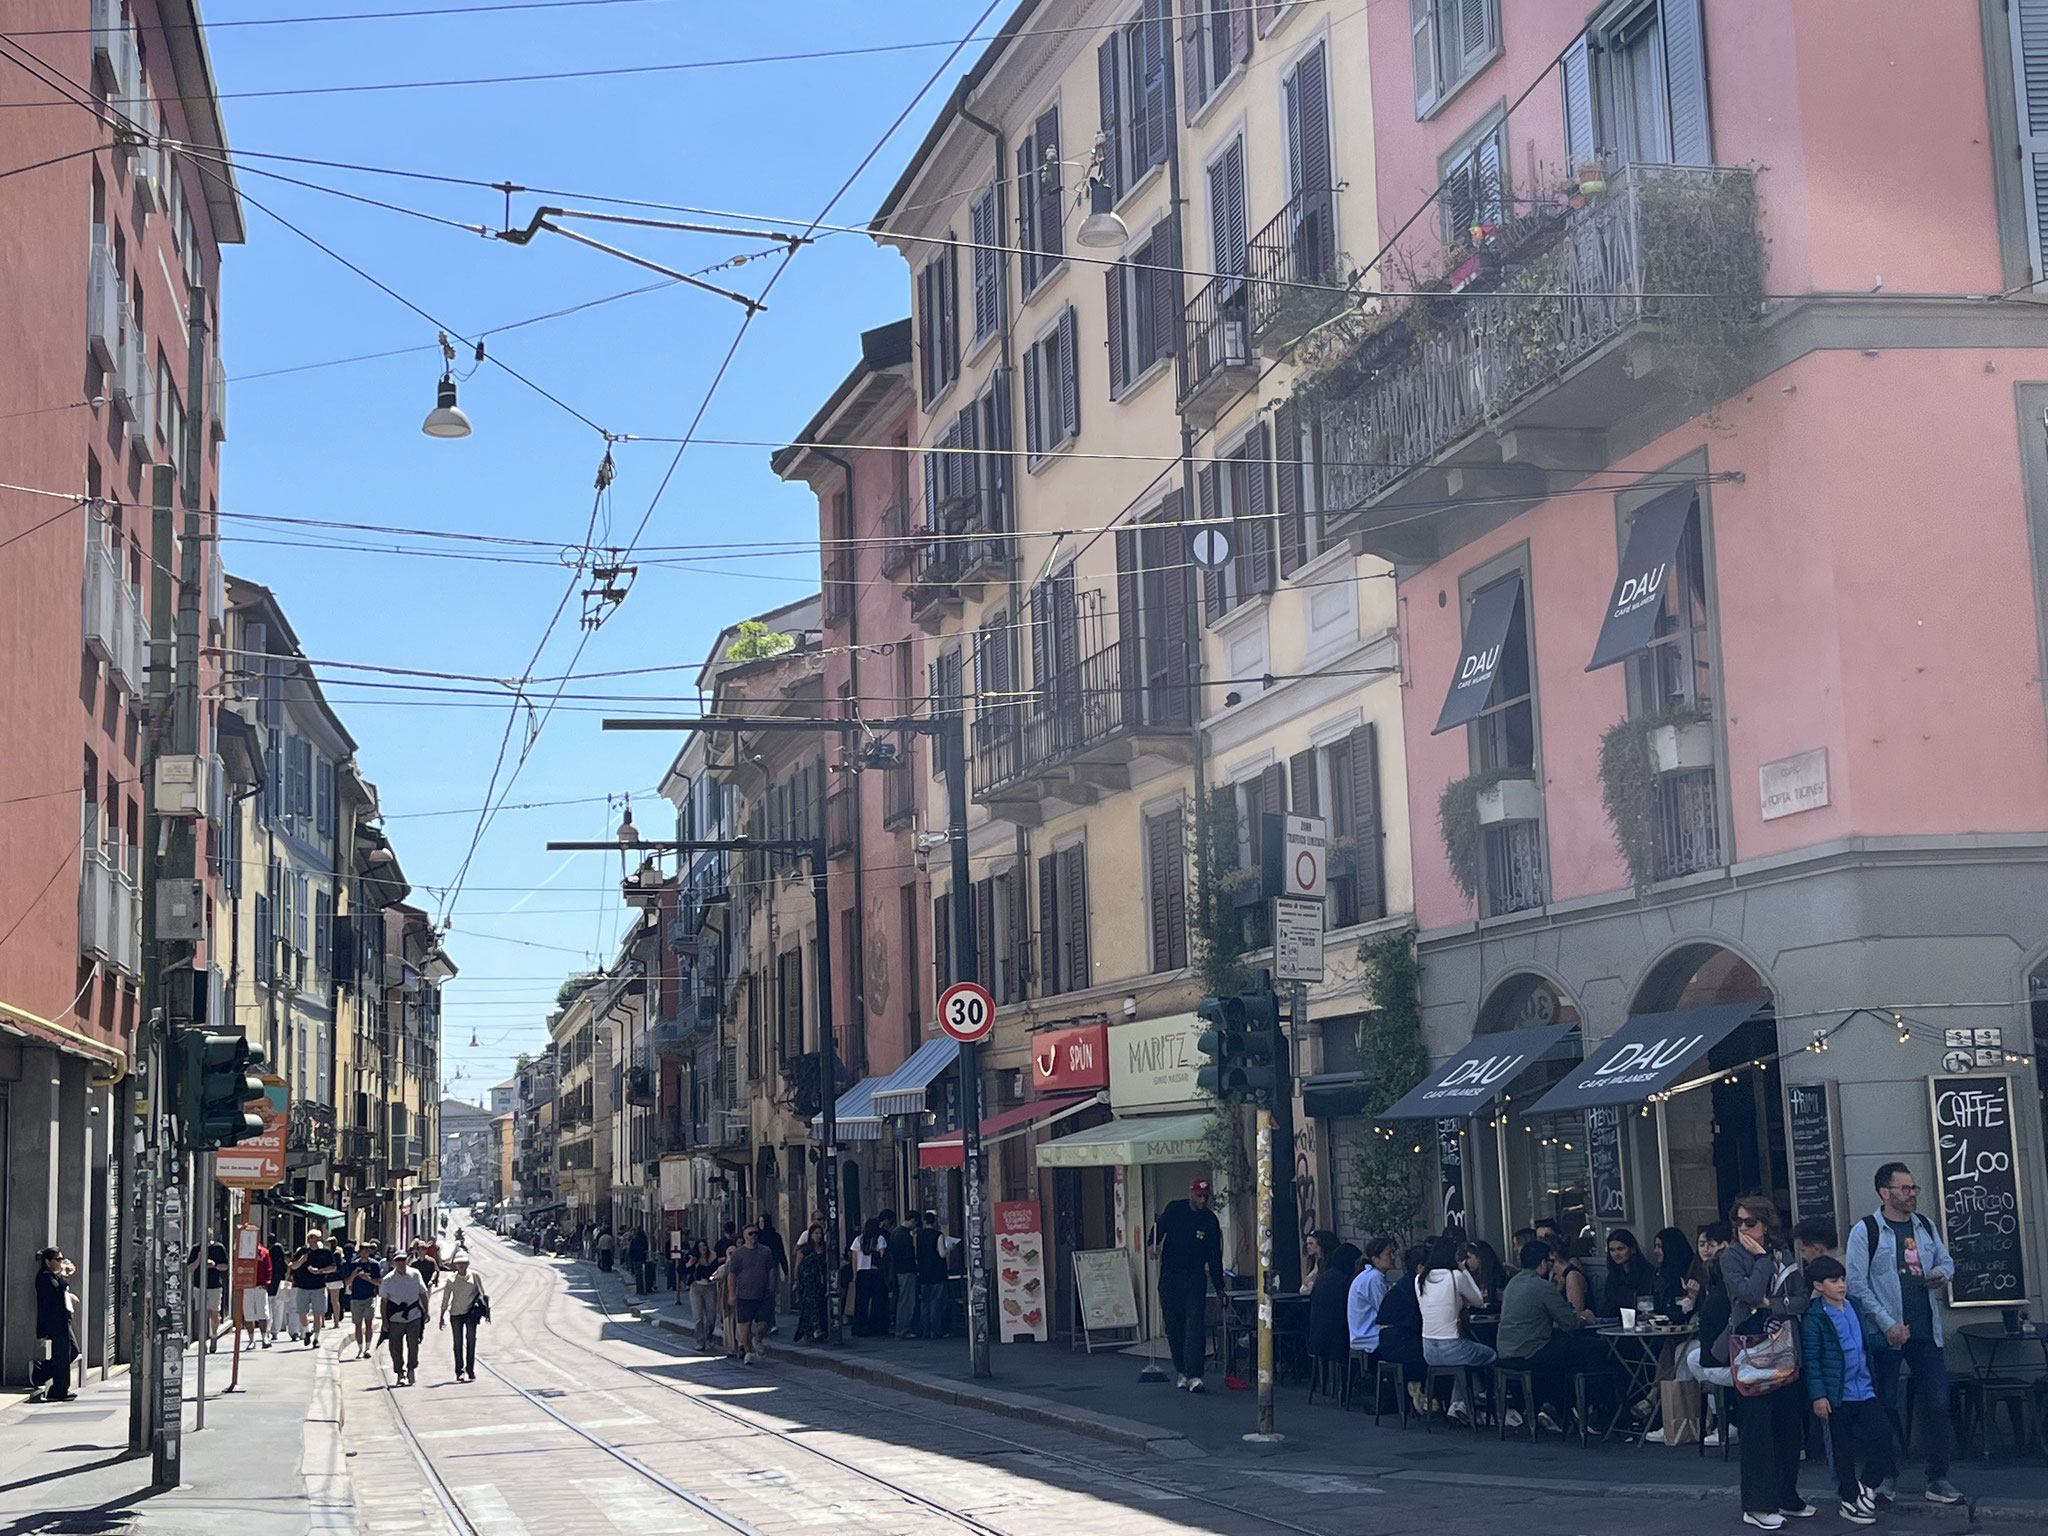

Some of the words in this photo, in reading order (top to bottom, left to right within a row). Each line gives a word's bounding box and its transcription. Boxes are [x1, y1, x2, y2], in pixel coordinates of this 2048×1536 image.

[1618, 563, 1666, 606] DAU
[1461, 644, 1500, 679] DAU
[951, 998, 983, 1025] 30
[1128, 1032, 1189, 1074] MARITZ
[1437, 1054, 1524, 1087] DAU
[1594, 1034, 1704, 1075] DAU
